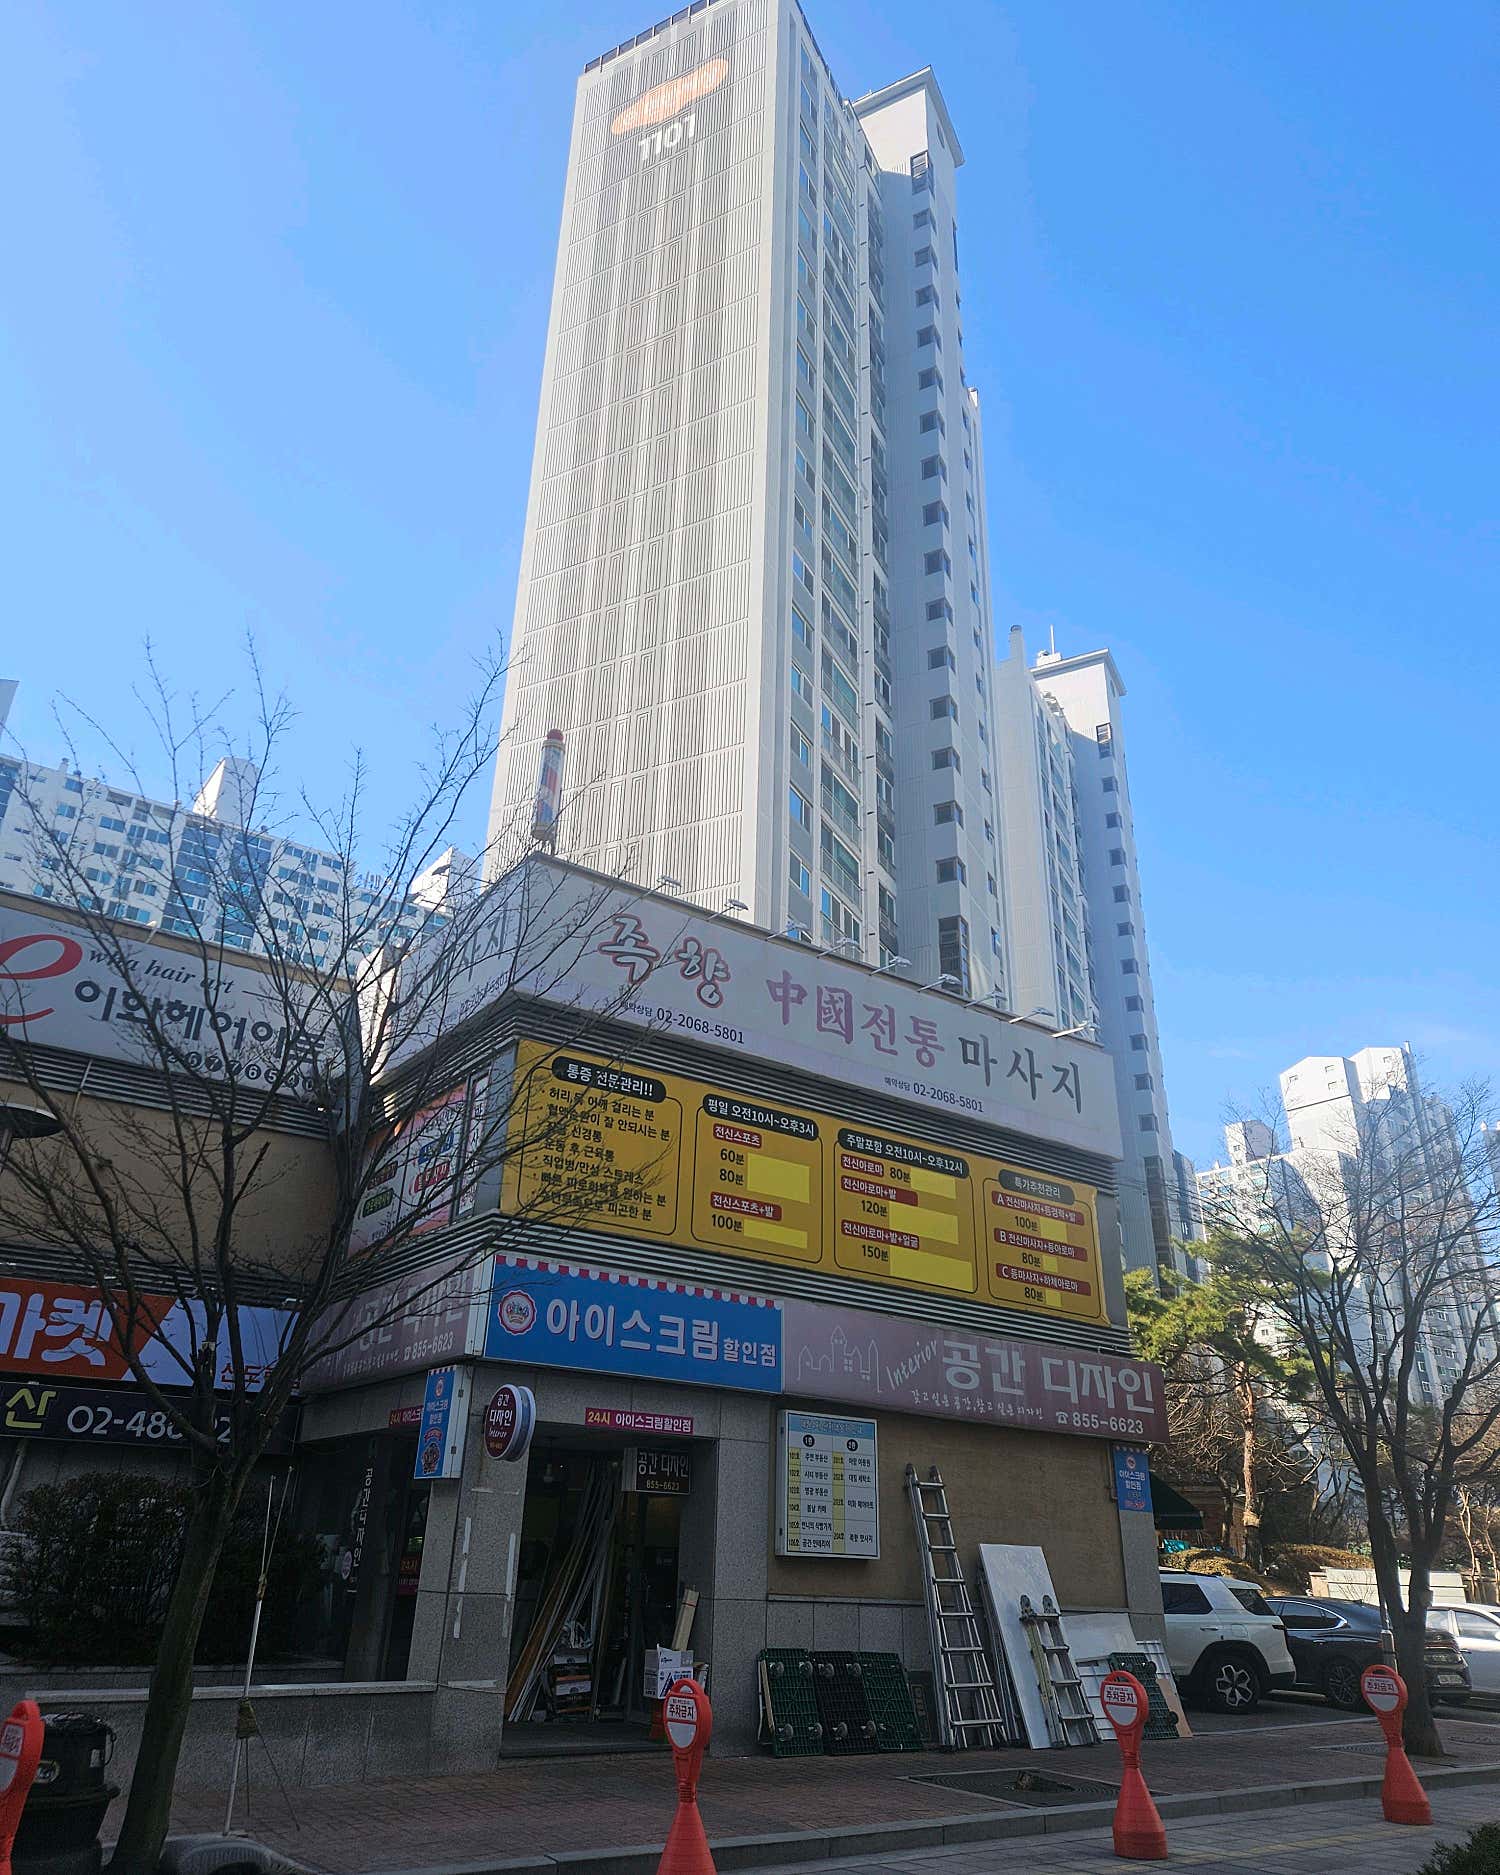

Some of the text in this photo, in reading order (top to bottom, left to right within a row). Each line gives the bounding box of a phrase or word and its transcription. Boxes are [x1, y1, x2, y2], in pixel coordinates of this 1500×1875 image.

[639, 112, 696, 160] 1101
[598, 914, 731, 1008] 족향
[144, 959, 196, 984] hair
[200, 976, 235, 995] art
[657, 1006, 745, 1044] 02-2068-5801
[566, 1062, 653, 1097] 통증 전문관리!!
[958, 1033, 1082, 1115] 마사지
[913, 1081, 985, 1113] 02-2068-5801
[611, 1100, 642, 1117] 결리는
[645, 1108, 655, 1122] 분
[708, 1098, 815, 1137] 평일 오전10시~오후3시
[617, 1118, 657, 1138] 안되시는
[660, 1129, 670, 1142] 분
[714, 1125, 761, 1147] 전신스포츠
[720, 1148, 745, 1166] 60분
[847, 1134, 964, 1175] 주말포함 오전10시~오후12시
[719, 1168, 744, 1186] 80분
[842, 1155, 911, 1184] 전신아로마 80분
[657, 1193, 666, 1207] 분
[843, 1178, 897, 1201] 전신아로마+발
[997, 1193, 1005, 1205] A
[642, 1208, 653, 1222] 분
[712, 1193, 774, 1218] 전신스포츠+발
[861, 1199, 888, 1218] 120분
[711, 1214, 743, 1233] 100분
[1014, 1215, 1039, 1232] 100분
[999, 1231, 1007, 1243] B
[861, 1244, 889, 1262] 150분
[1022, 1252, 1042, 1268] 80분
[1002, 1265, 1009, 1278] C
[1024, 1286, 1045, 1303] 80분
[546, 1298, 777, 1369] 아이스크림 할인점
[886, 1338, 937, 1392] Interior
[943, 1340, 1155, 1414] 공간 디자인
[489, 1409, 513, 1428] 디자인
[587, 1409, 692, 1434] 24시 아이스크림할인점
[1072, 1411, 1144, 1434] 855-6623
[638, 1451, 689, 1478] 공간 디자인
[1106, 1691, 1135, 1704] 주차금지
[669, 1704, 694, 1719] 주차금지
